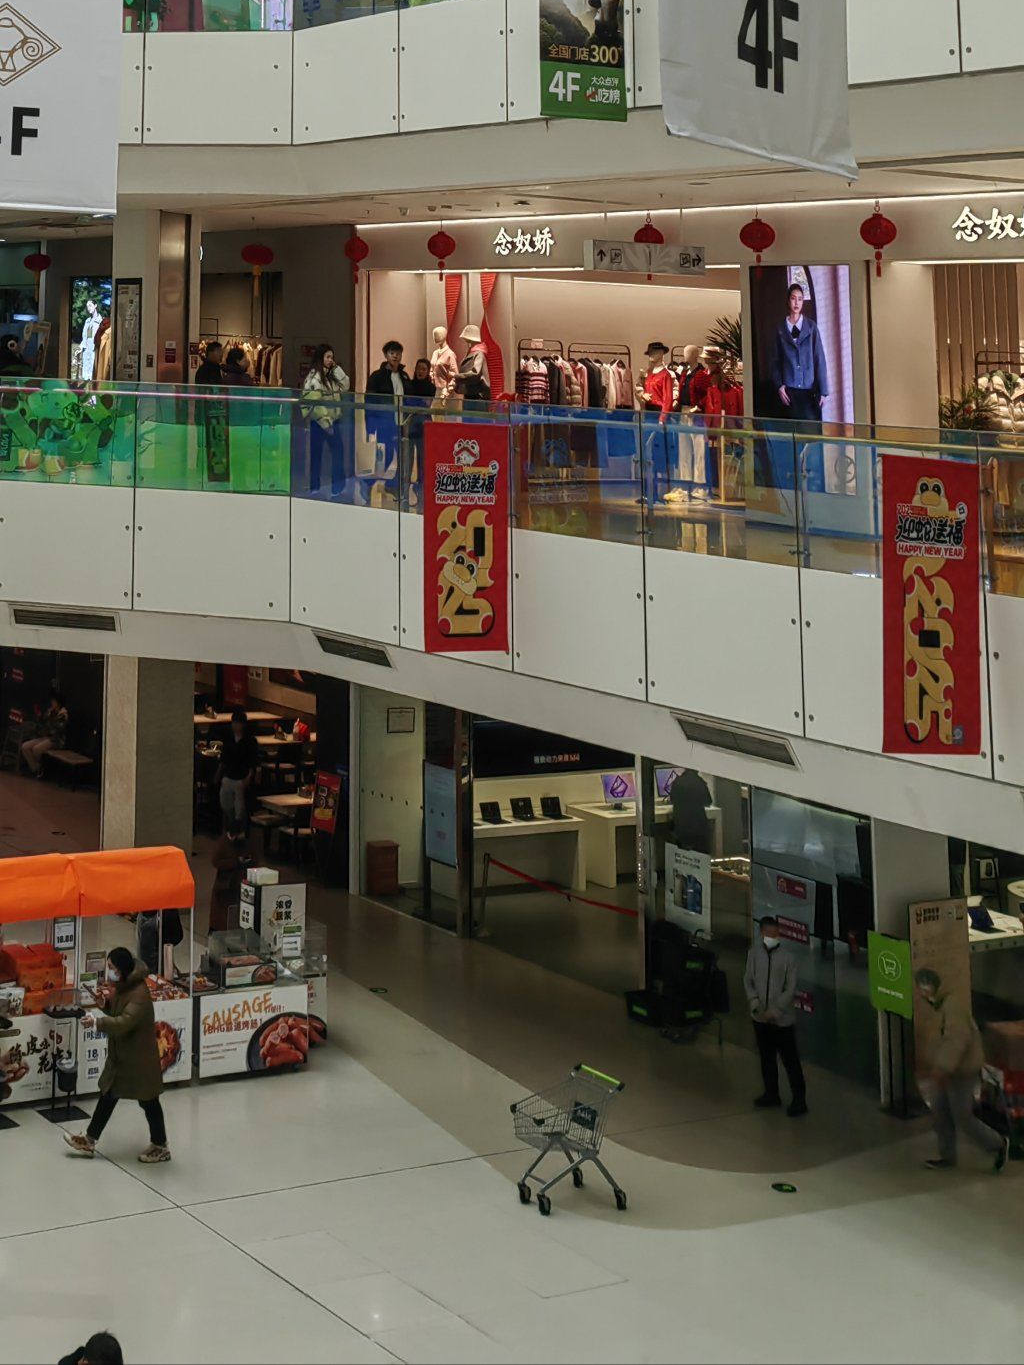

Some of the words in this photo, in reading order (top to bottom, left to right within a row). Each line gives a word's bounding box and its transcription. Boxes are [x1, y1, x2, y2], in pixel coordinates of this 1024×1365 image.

[548, 70, 582, 103] 4F
[952, 205, 1024, 243] 念奴
[492, 226, 555, 257] 念奴娇
[897, 542, 923, 554] HAPPY
[924, 545, 943, 555] NEW
[943, 547, 964, 558] YEAR
[201, 991, 273, 1027] SAUSAGE
